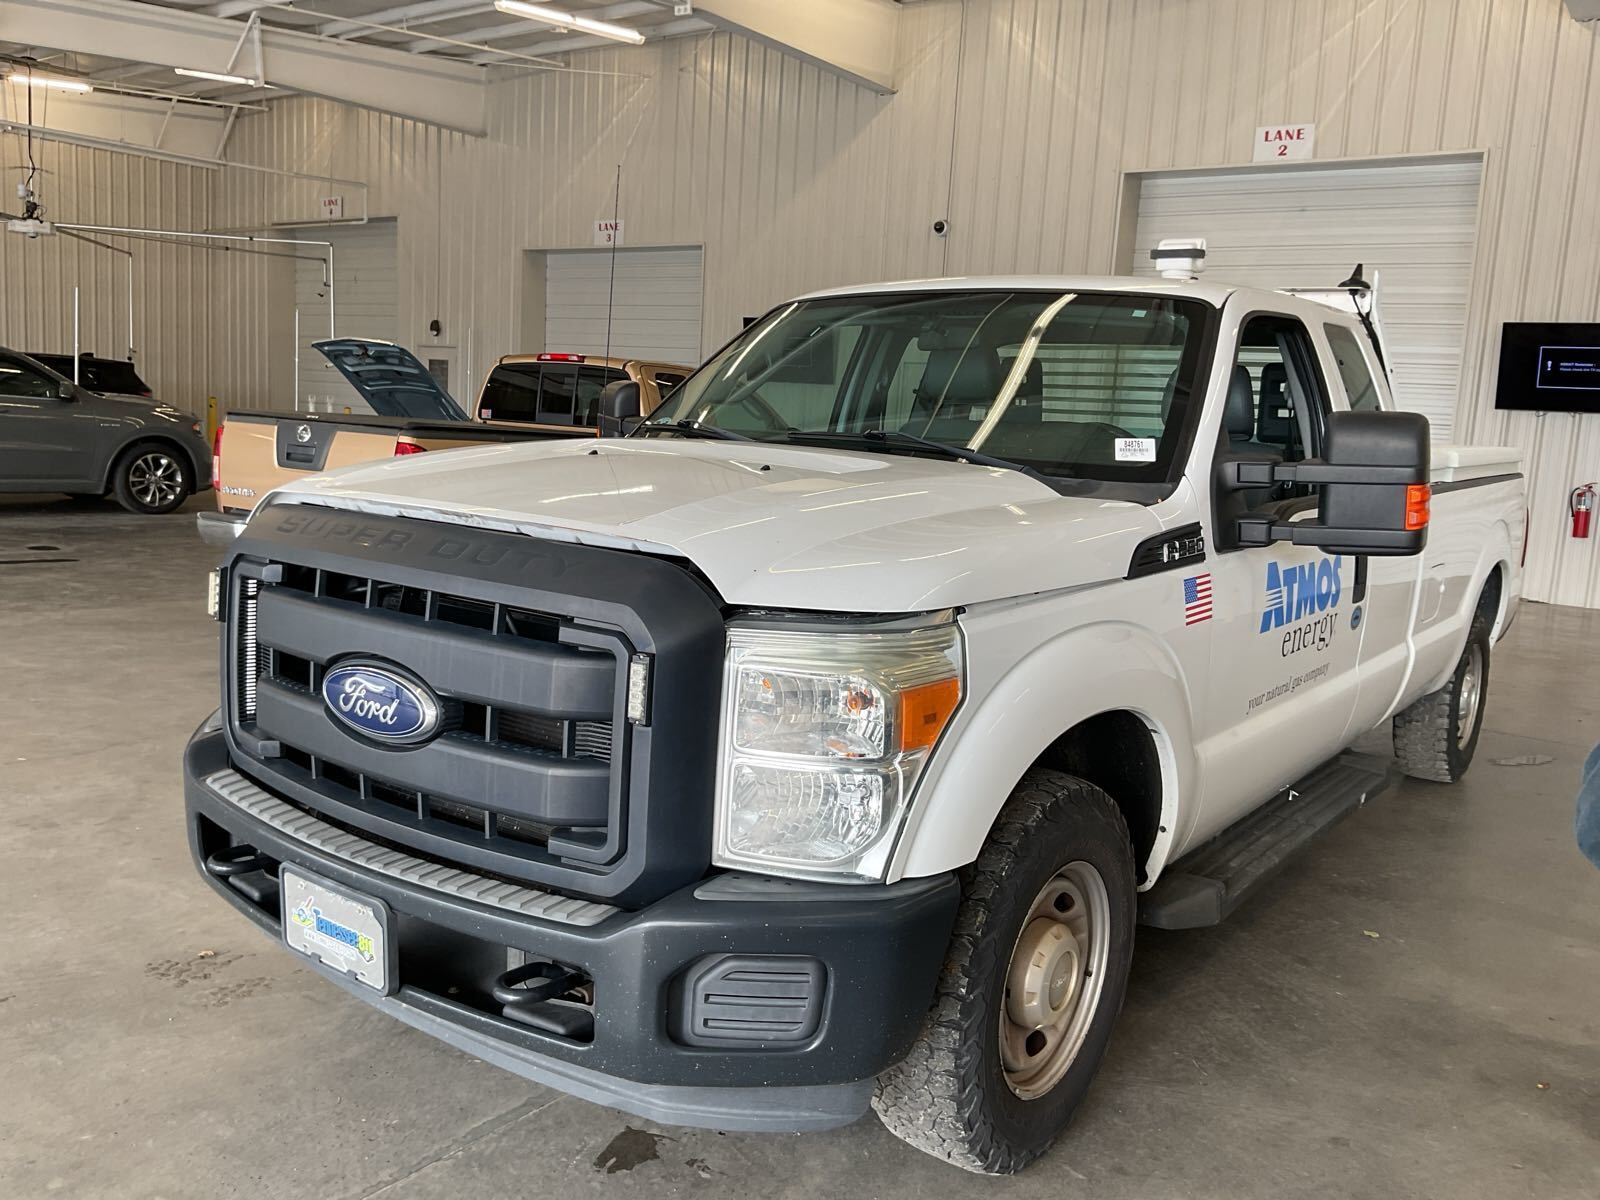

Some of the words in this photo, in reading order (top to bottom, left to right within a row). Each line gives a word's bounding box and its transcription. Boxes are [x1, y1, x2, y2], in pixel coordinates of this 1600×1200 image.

[1264, 128, 1306, 142] LANE
[1278, 144, 1288, 157] 2
[598, 222, 620, 231] LANE
[606, 233, 612, 243] 3
[276, 514, 416, 553] SUPER
[428, 536, 584, 579] DUTY
[1260, 554, 1342, 634] ATMOS
[1281, 612, 1339, 658] energy
[339, 676, 400, 725] Ford
[1245, 693, 1266, 716] your
[1265, 675, 1293, 702] natural
[1290, 676, 1304, 693] gas
[1302, 662, 1331, 684] company
